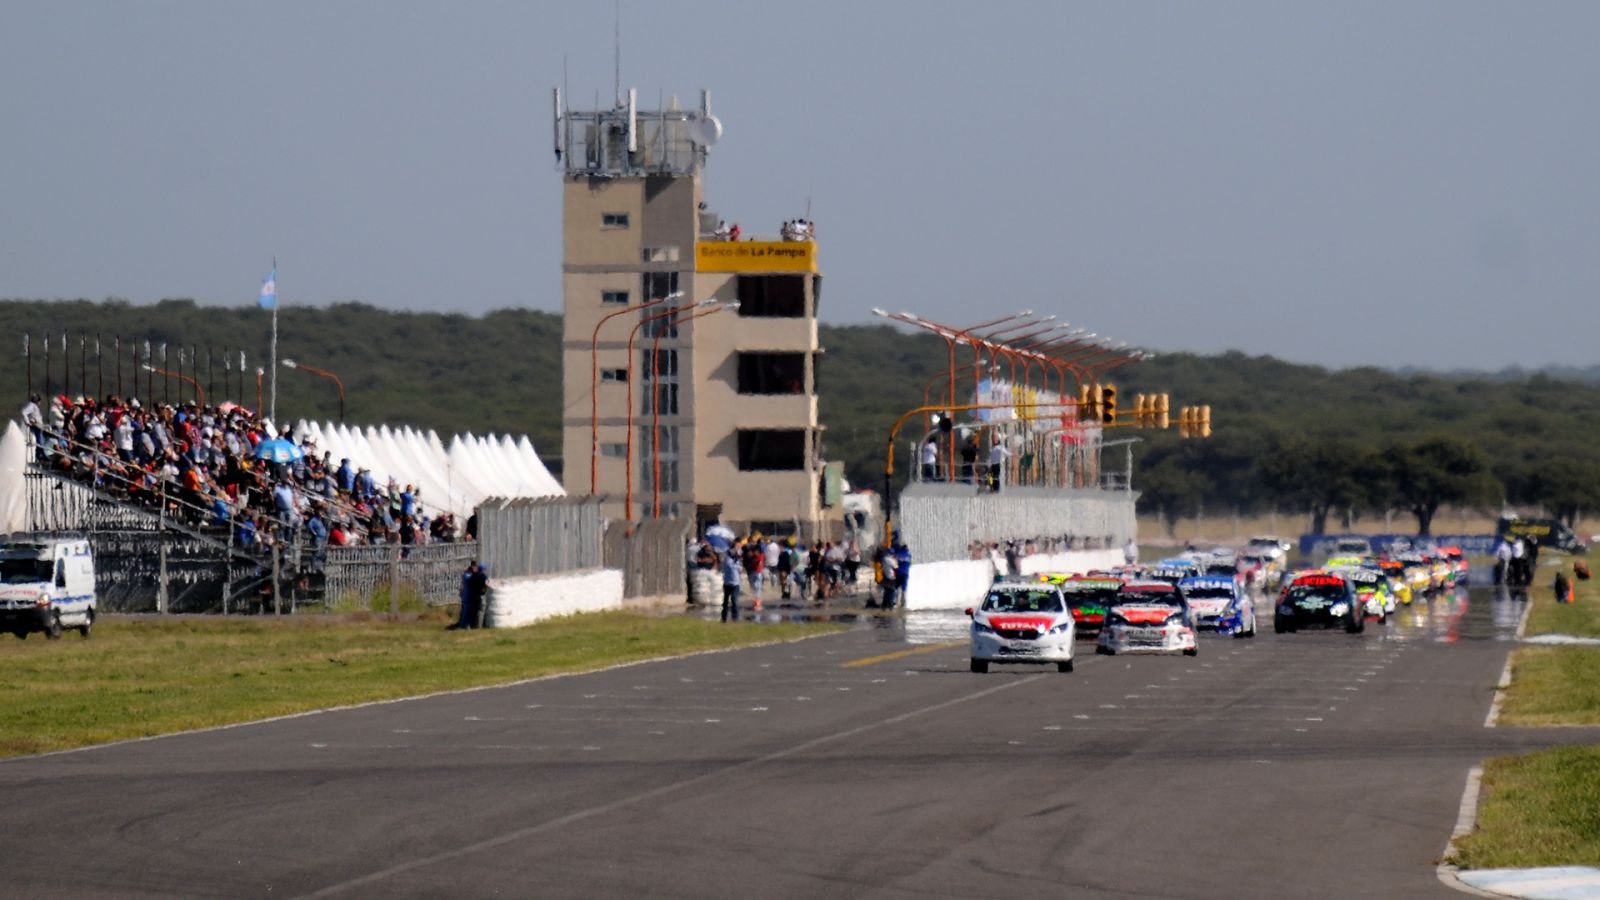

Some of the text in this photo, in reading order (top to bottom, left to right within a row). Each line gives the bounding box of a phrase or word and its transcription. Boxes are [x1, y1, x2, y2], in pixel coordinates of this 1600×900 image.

[702, 247, 733, 257] Banco
[751, 247, 765, 257] La
[768, 247, 806, 259] Pampa
[1000, 622, 1038, 630] TOTAL
